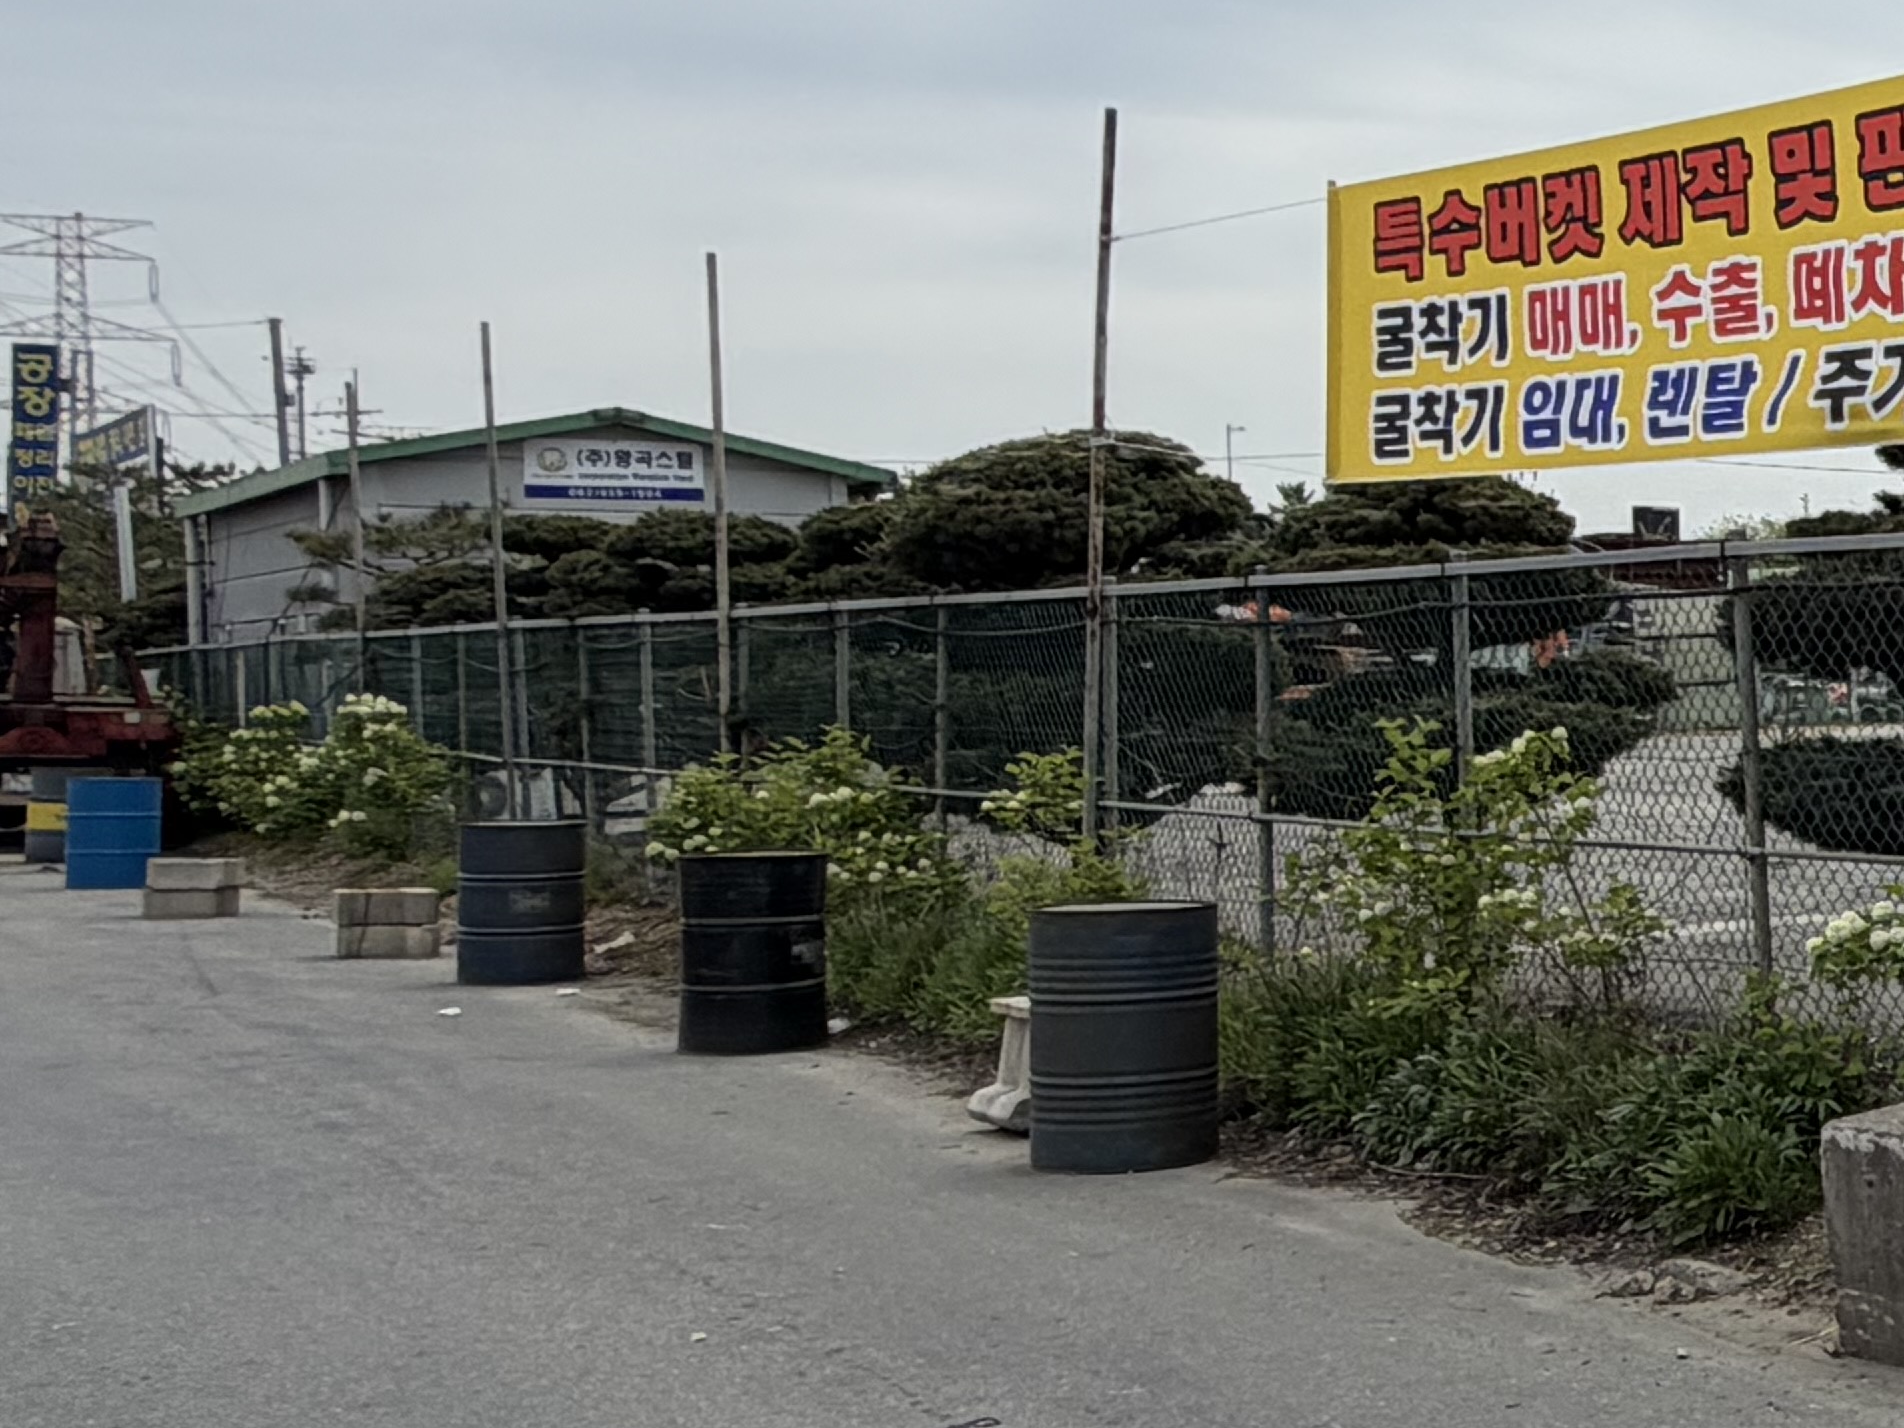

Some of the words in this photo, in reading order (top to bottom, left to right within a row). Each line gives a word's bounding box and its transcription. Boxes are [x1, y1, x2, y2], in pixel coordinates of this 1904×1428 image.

[1373, 165, 1605, 282] 특수버켓
[1617, 134, 1751, 249] 제작
[1768, 117, 1839, 231] 및
[1377, 300, 1508, 372] 굴착기
[1529, 281, 1635, 352] 매매,
[1656, 260, 1773, 336] 수출,
[1373, 386, 1503, 459] 굴착기
[1523, 375, 1625, 448] 임대,
[1646, 358, 1755, 437] 렌탈
